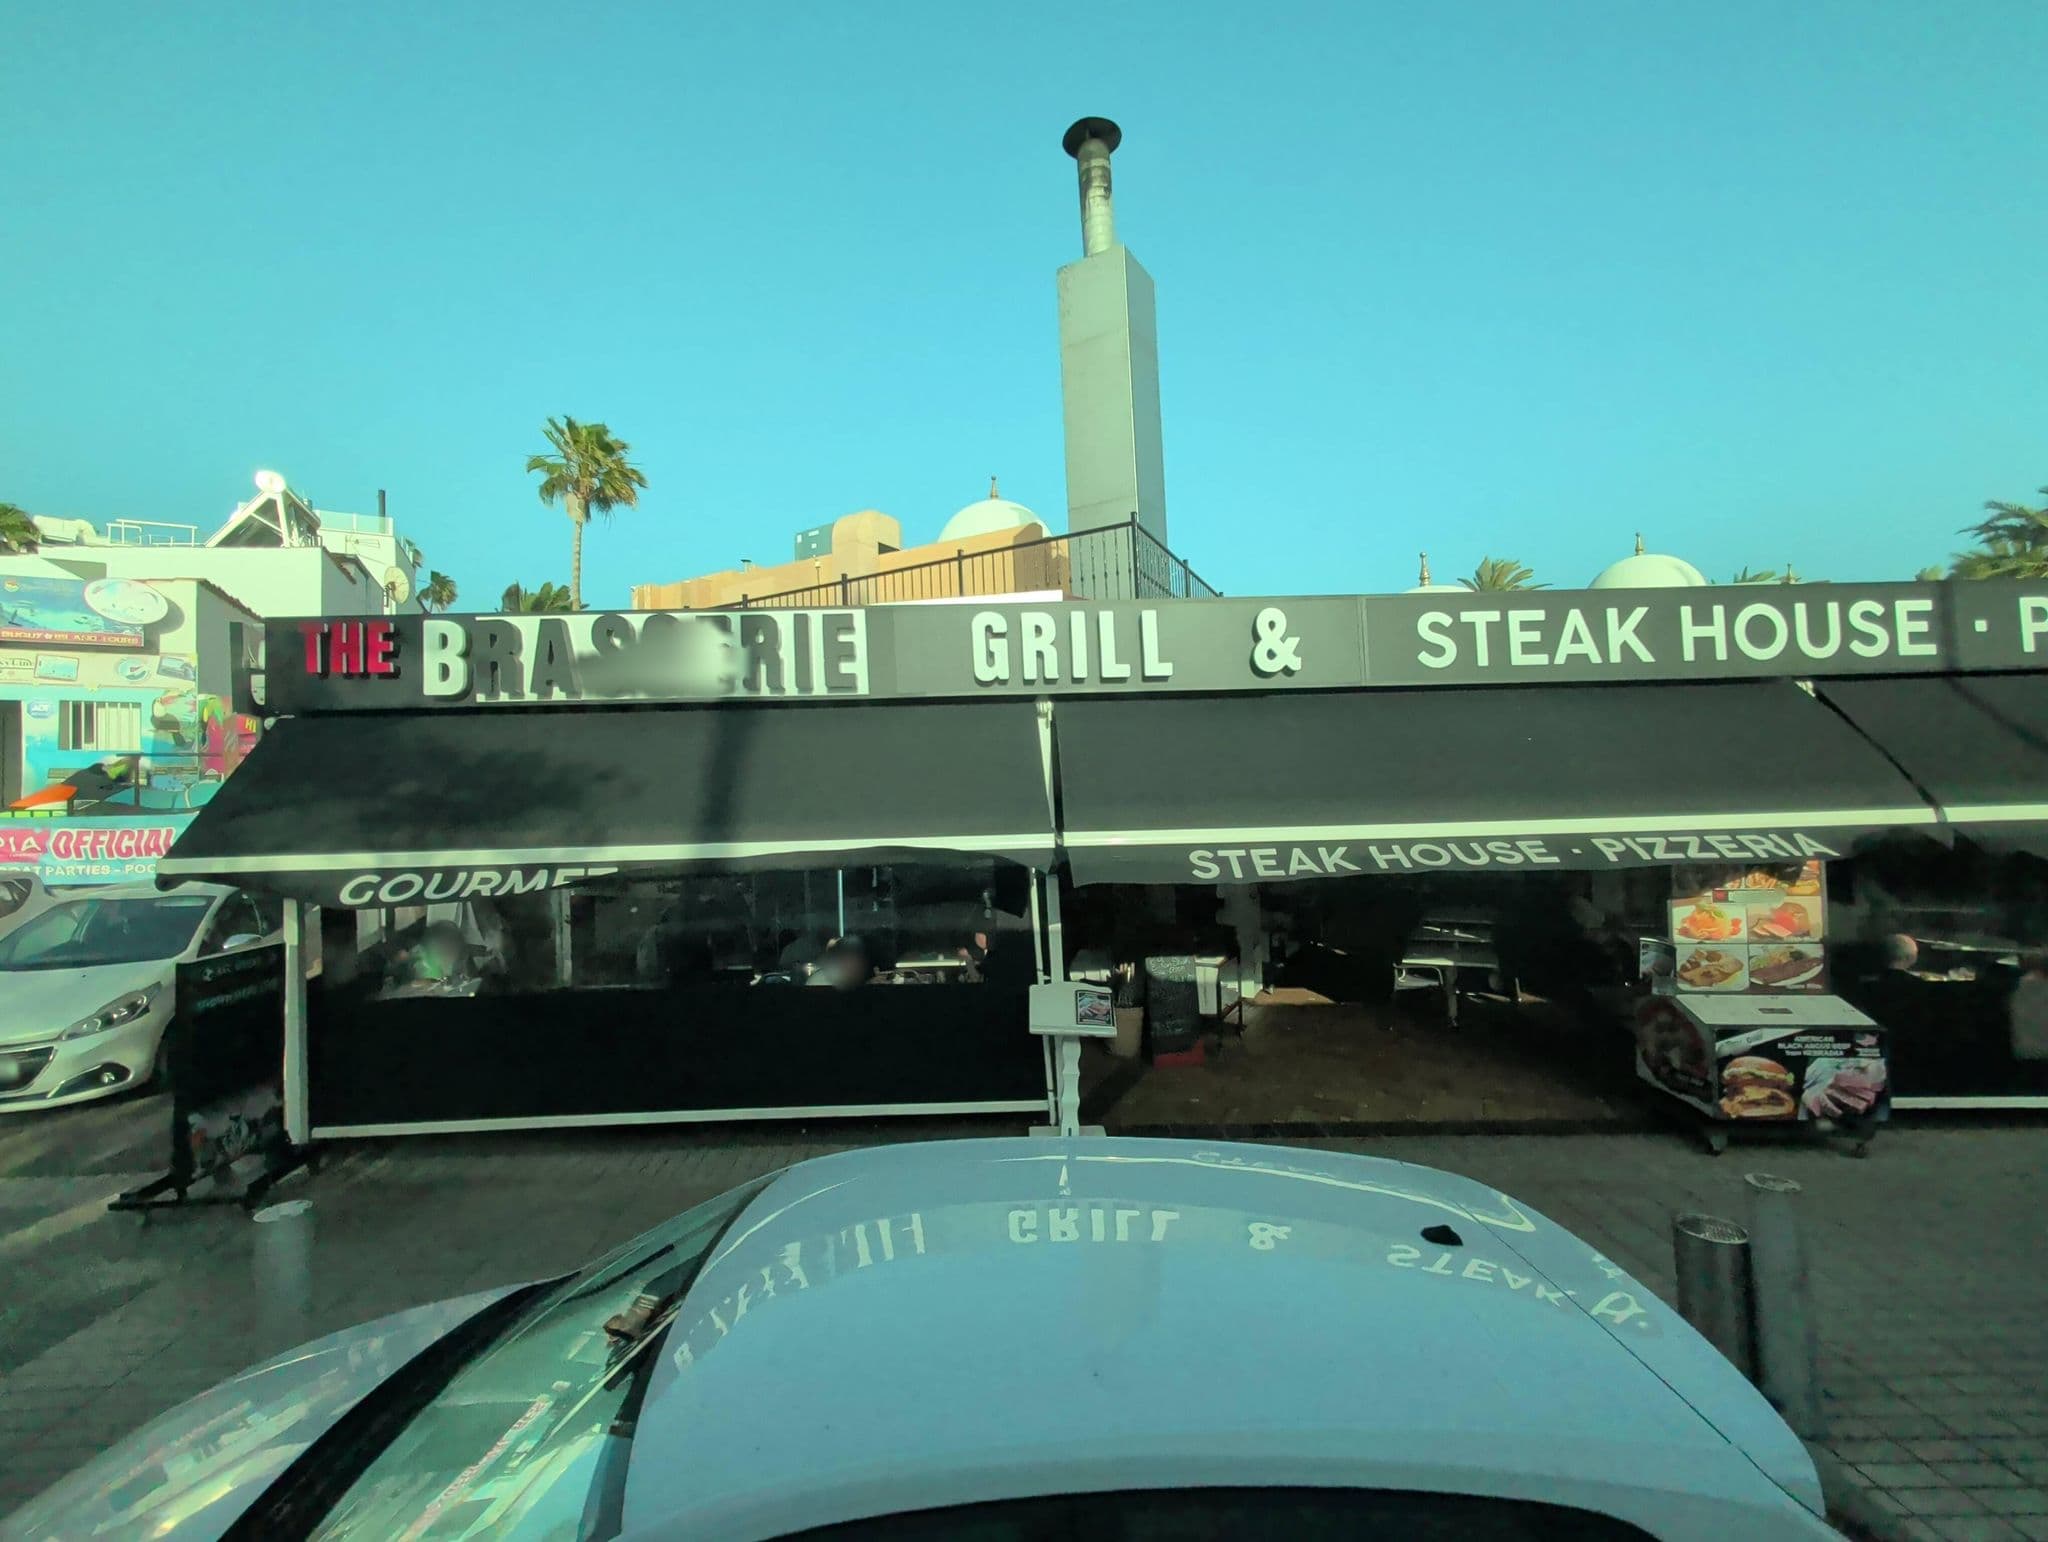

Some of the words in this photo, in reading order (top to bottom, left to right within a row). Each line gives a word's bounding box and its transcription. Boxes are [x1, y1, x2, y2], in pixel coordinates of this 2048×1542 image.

[298, 620, 396, 678] THE
[971, 609, 1174, 682] GRILL
[1252, 607, 1302, 674] &
[1417, 605, 1654, 668] STEAK
[1681, 598, 1937, 661] HOUSE
[45, 864, 111, 876] PARTIES
[1189, 846, 1361, 880] STEAK
[1369, 840, 1560, 869] HOUSE
[1590, 832, 1841, 863] PIZZERIA
